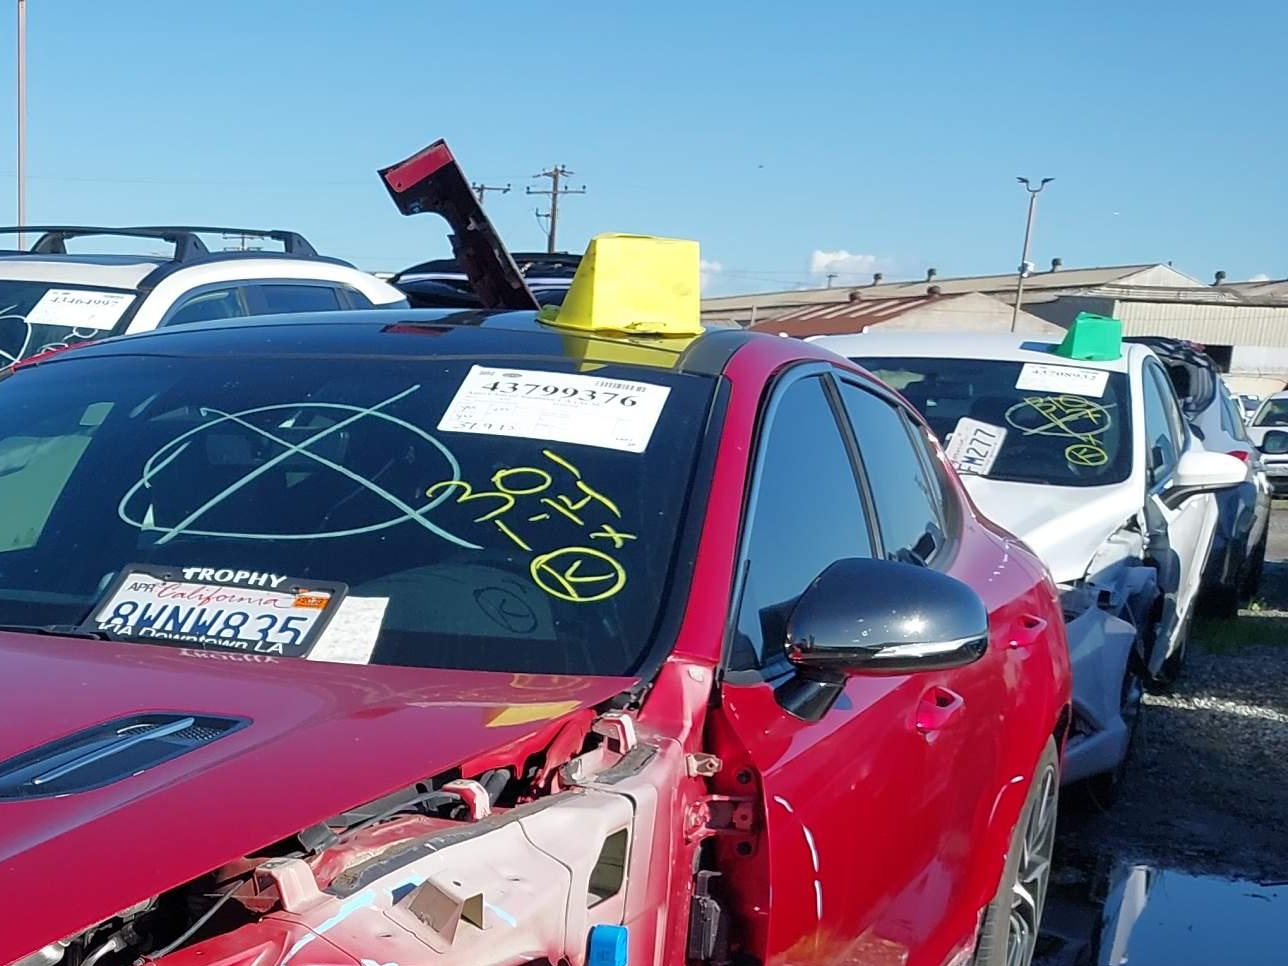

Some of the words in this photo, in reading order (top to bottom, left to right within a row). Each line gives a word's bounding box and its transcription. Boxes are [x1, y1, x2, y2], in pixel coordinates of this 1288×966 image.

[481, 381, 638, 407] 43799376
[128, 582, 156, 593] APR
[182, 567, 288, 588] TROPHY
[157, 582, 291, 608] California
[106, 600, 308, 646] 8WNW835
[253, 640, 283, 655] LA
